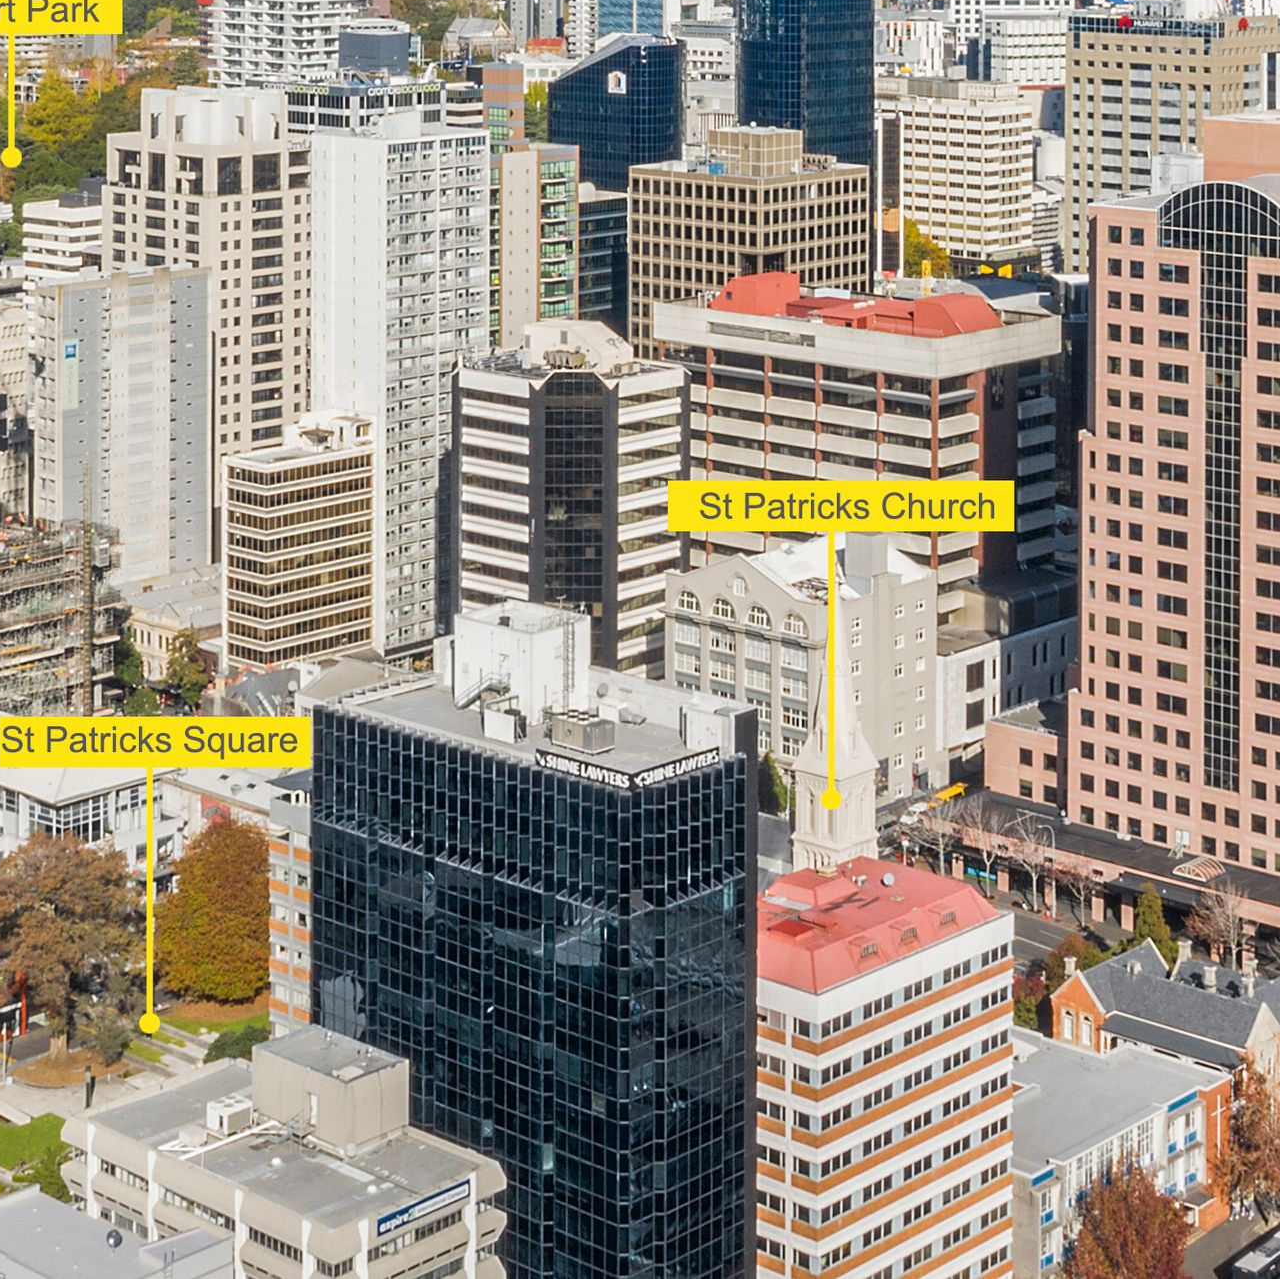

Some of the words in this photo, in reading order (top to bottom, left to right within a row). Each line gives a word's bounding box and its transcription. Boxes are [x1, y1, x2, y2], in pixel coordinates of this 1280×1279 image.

[545, 754, 580, 776] SHINE
[580, 763, 630, 788] LAWYERS
[644, 763, 676, 786] SHINE
[675, 750, 719, 775] LAWYERS
